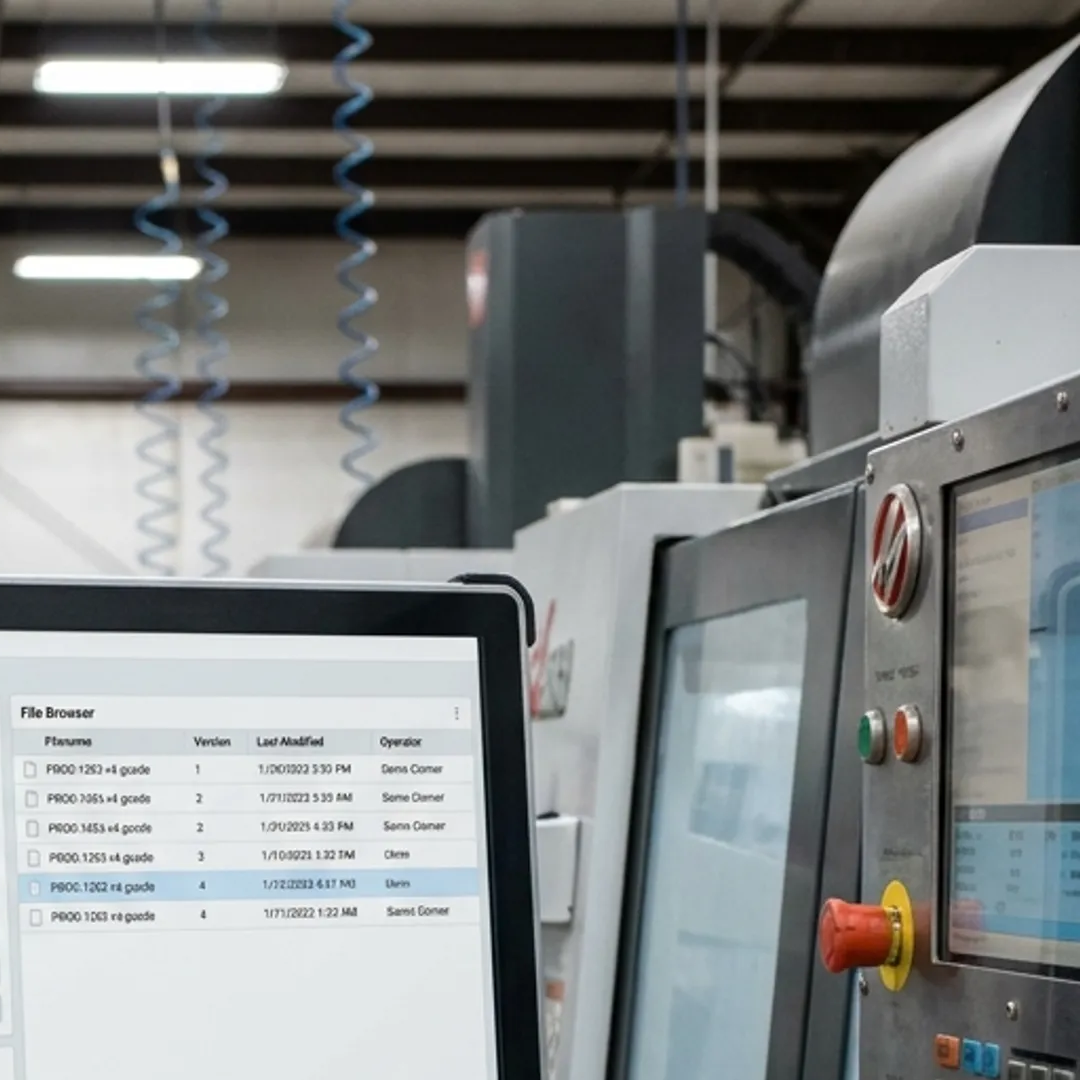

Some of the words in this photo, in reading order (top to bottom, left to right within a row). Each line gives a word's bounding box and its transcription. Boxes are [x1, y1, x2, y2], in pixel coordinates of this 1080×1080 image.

[21, 707, 43, 718] File
[336, 764, 351, 773] PM
[196, 793, 203, 804] 2
[197, 822, 203, 832] 2
[338, 821, 353, 831] PM
[198, 851, 204, 861] 3
[199, 881, 205, 889] 4
[201, 910, 206, 919] 4
